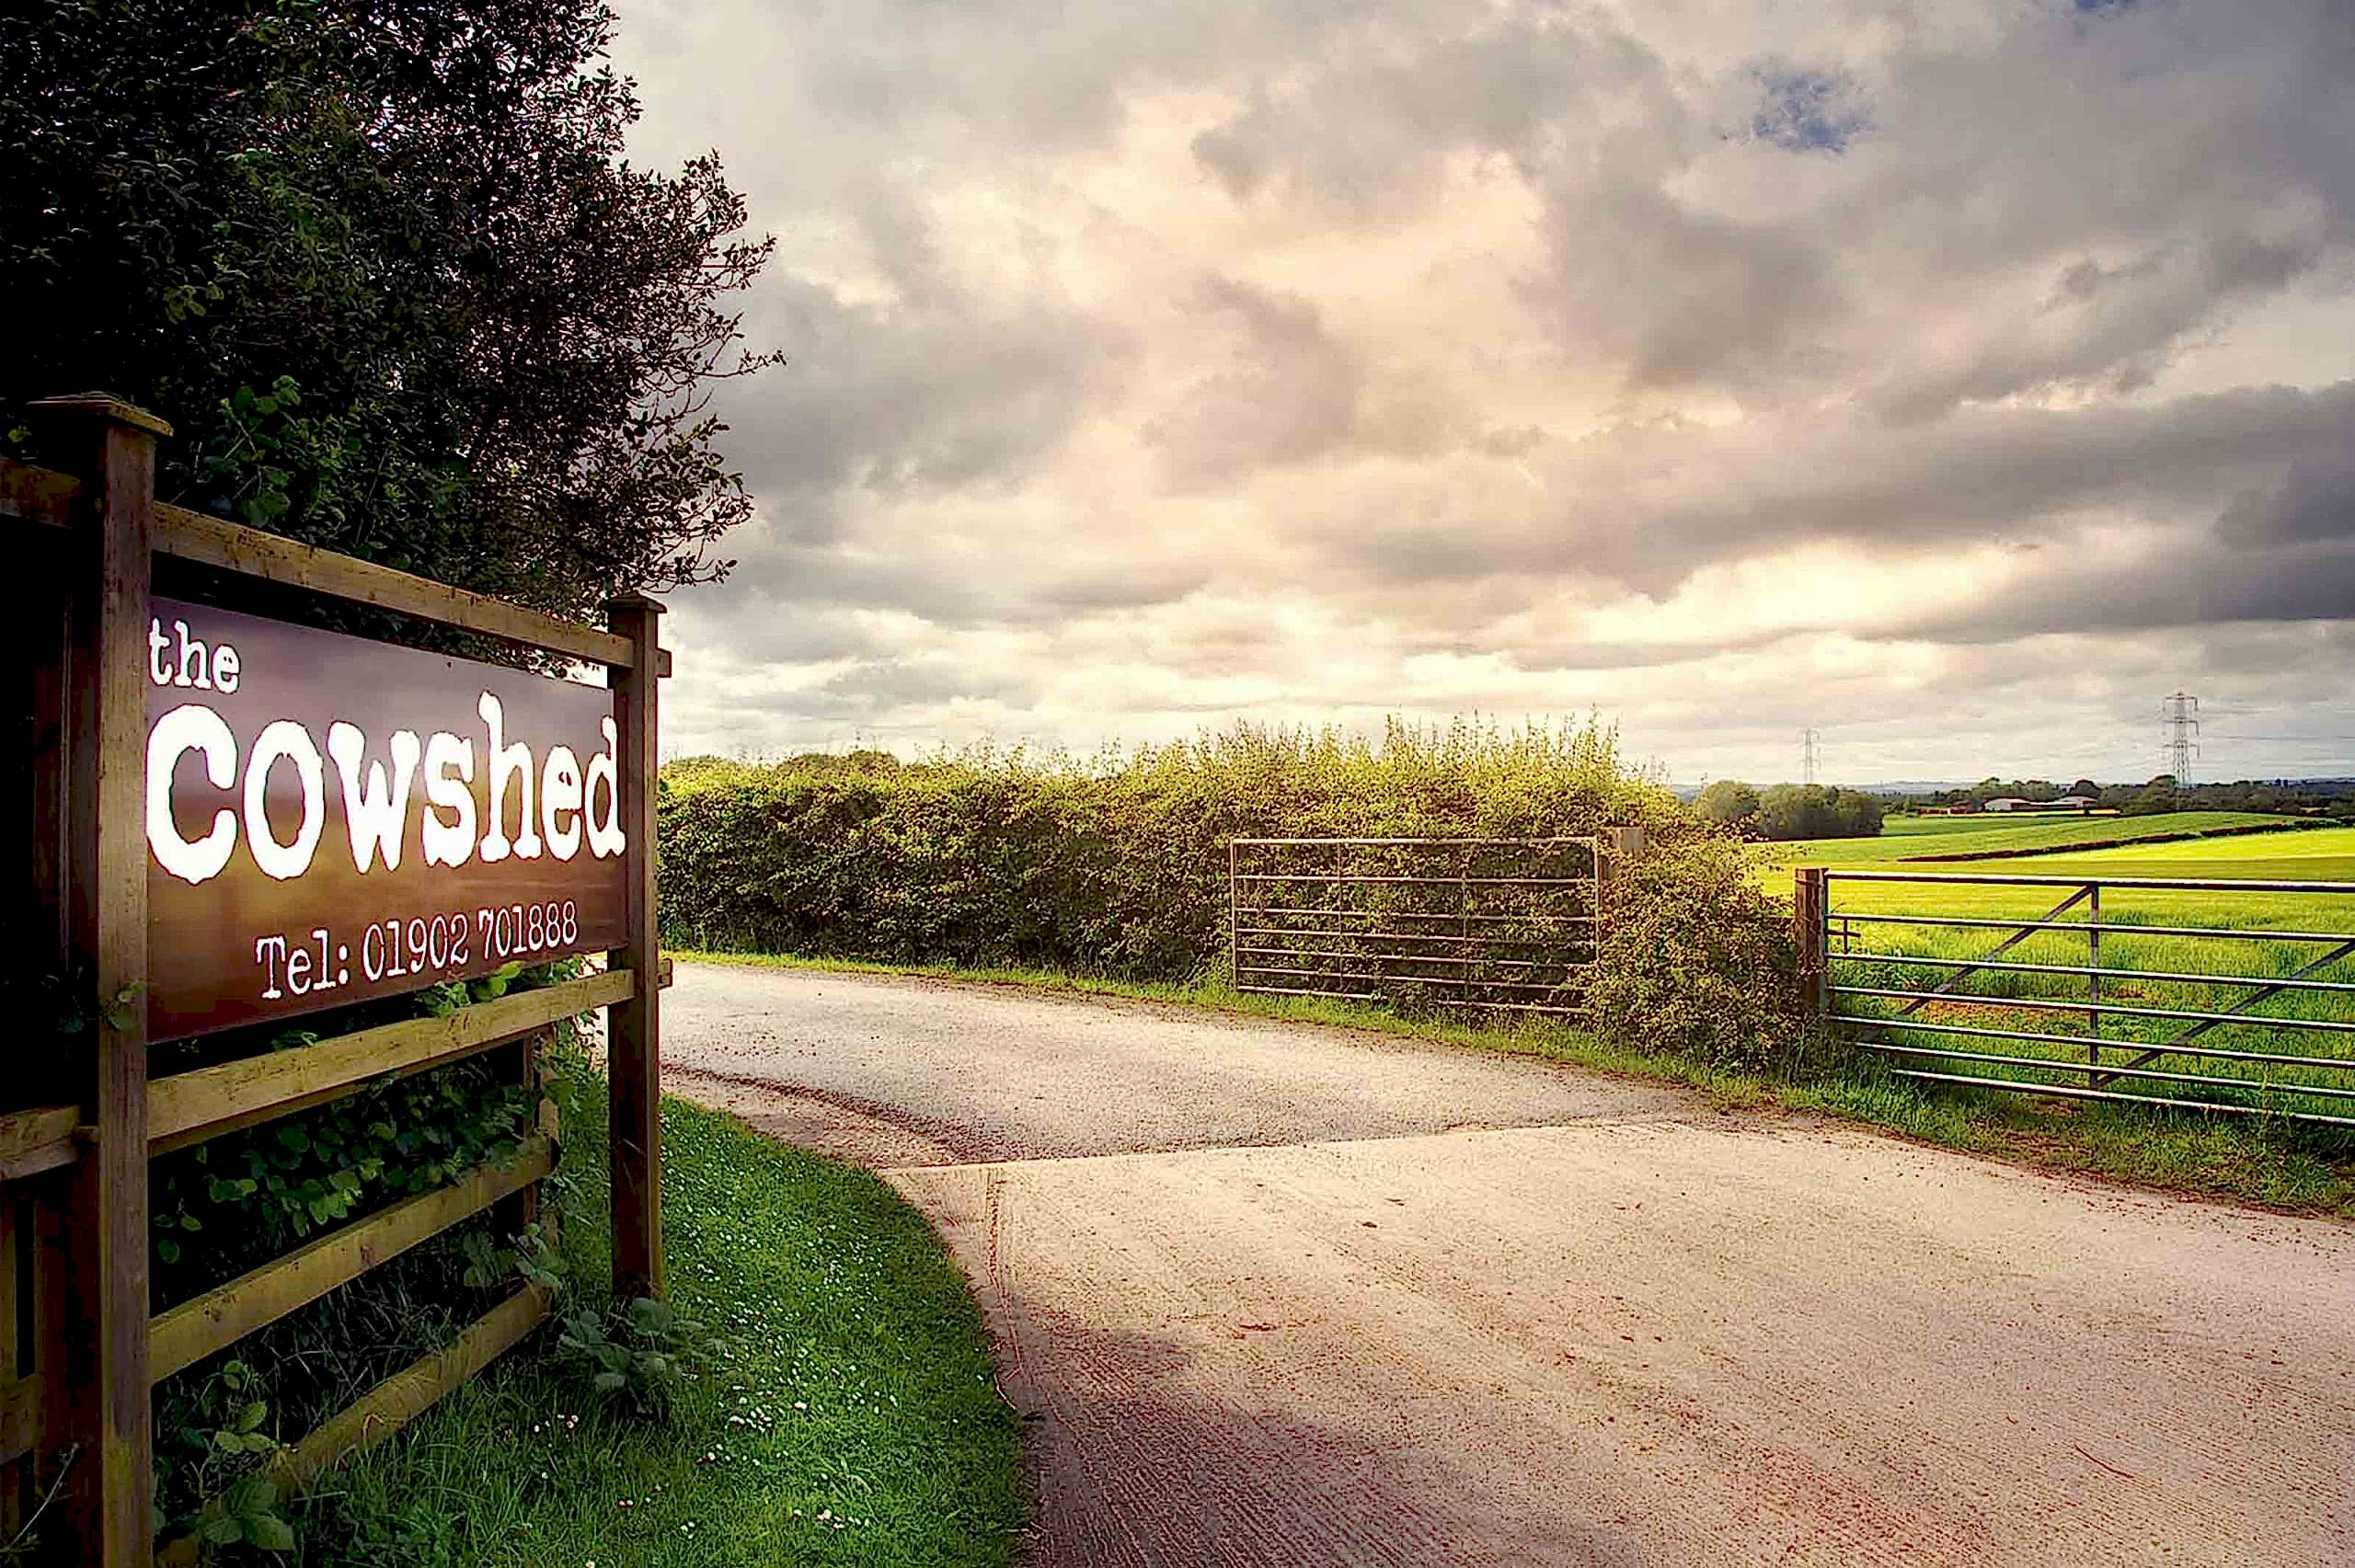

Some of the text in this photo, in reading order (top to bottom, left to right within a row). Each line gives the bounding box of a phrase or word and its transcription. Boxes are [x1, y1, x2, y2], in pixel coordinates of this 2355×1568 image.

[149, 617, 241, 694] the
[257, 900, 578, 999] Tel: 01902 701888
